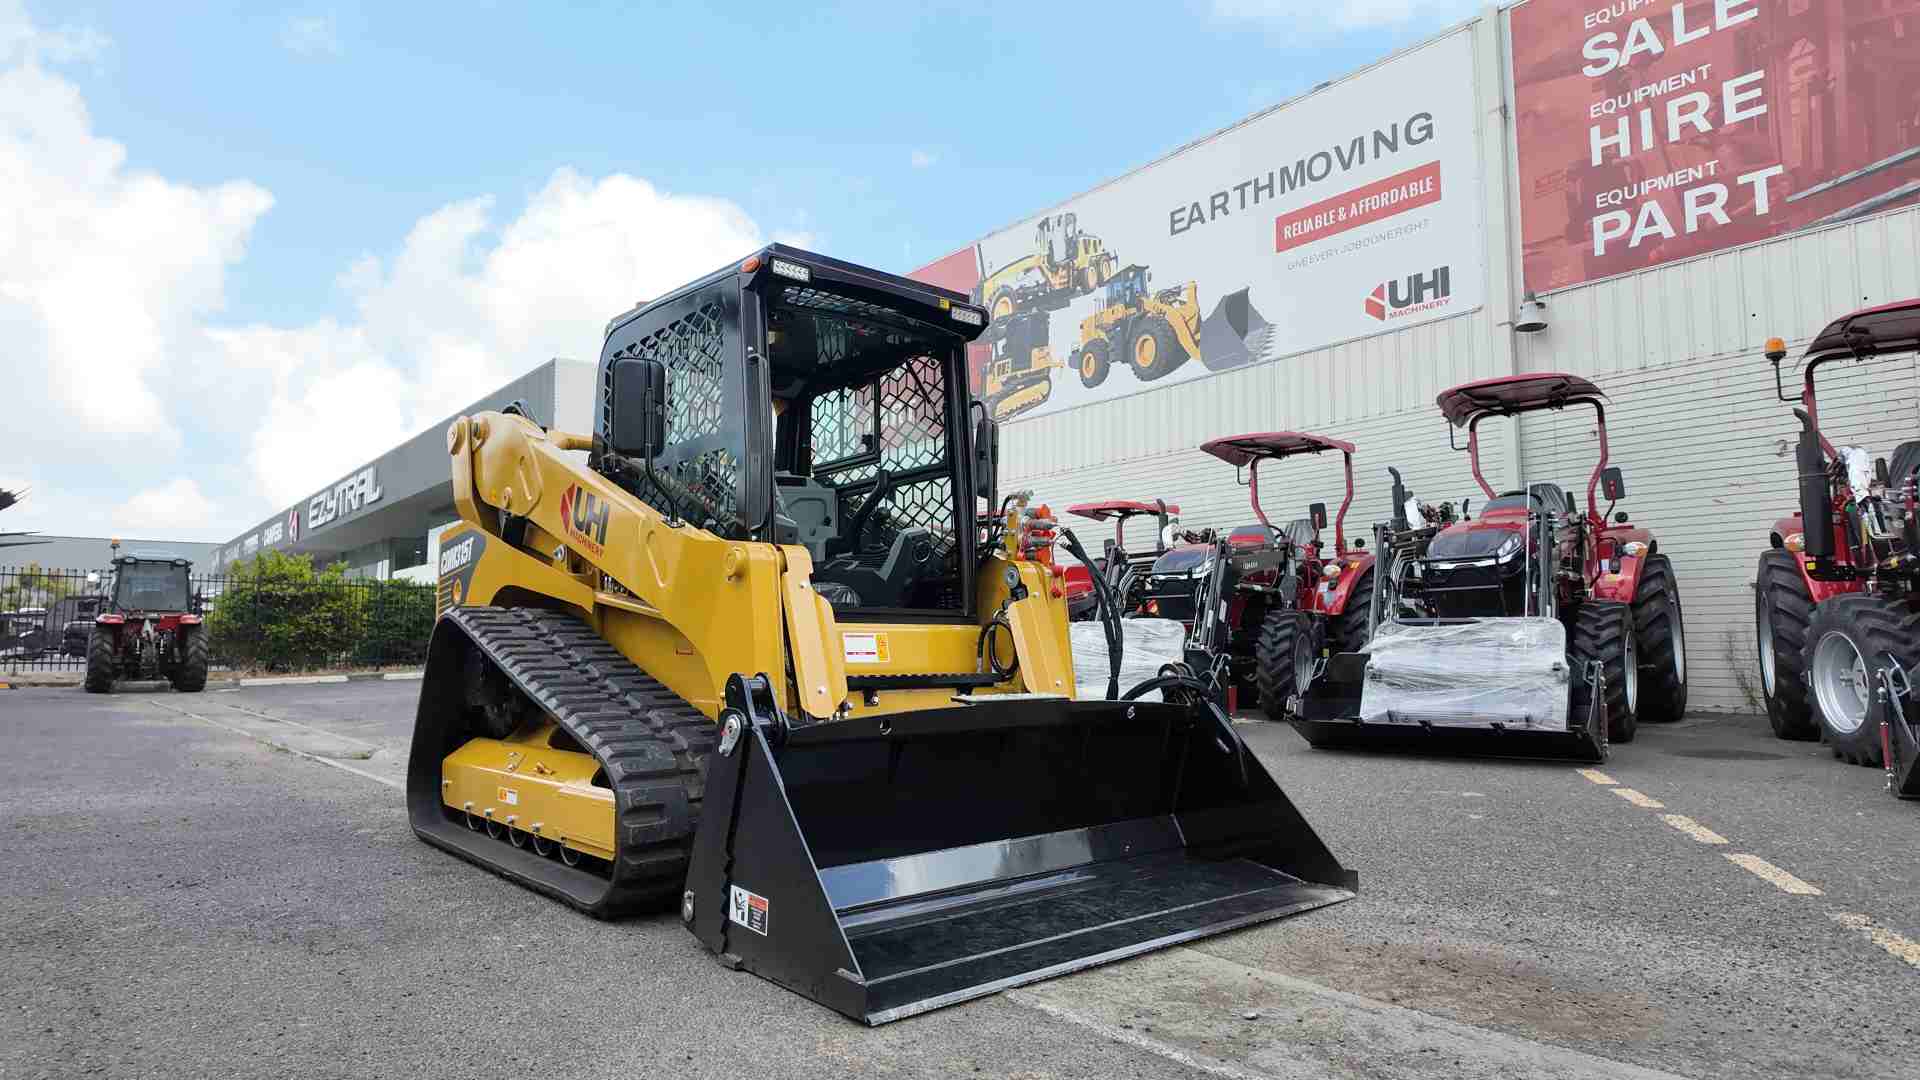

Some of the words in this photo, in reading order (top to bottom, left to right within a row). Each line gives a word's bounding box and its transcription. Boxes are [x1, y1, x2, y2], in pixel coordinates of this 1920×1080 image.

[1582, 0, 1759, 77] SALE
[1590, 64, 1712, 118] EQUIPMENT
[1590, 70, 1767, 167] HIRE
[1169, 112, 1434, 236] EARTHMOVING
[1596, 160, 1719, 208] EQUIPMENT
[1283, 209, 1337, 240] RELIABLE
[1337, 207, 1347, 221] &
[1350, 176, 1433, 218] AFFORDABLE
[1592, 165, 1784, 257] PART
[1388, 265, 1450, 308] UHI
[1389, 299, 1449, 319] MACHINERY
